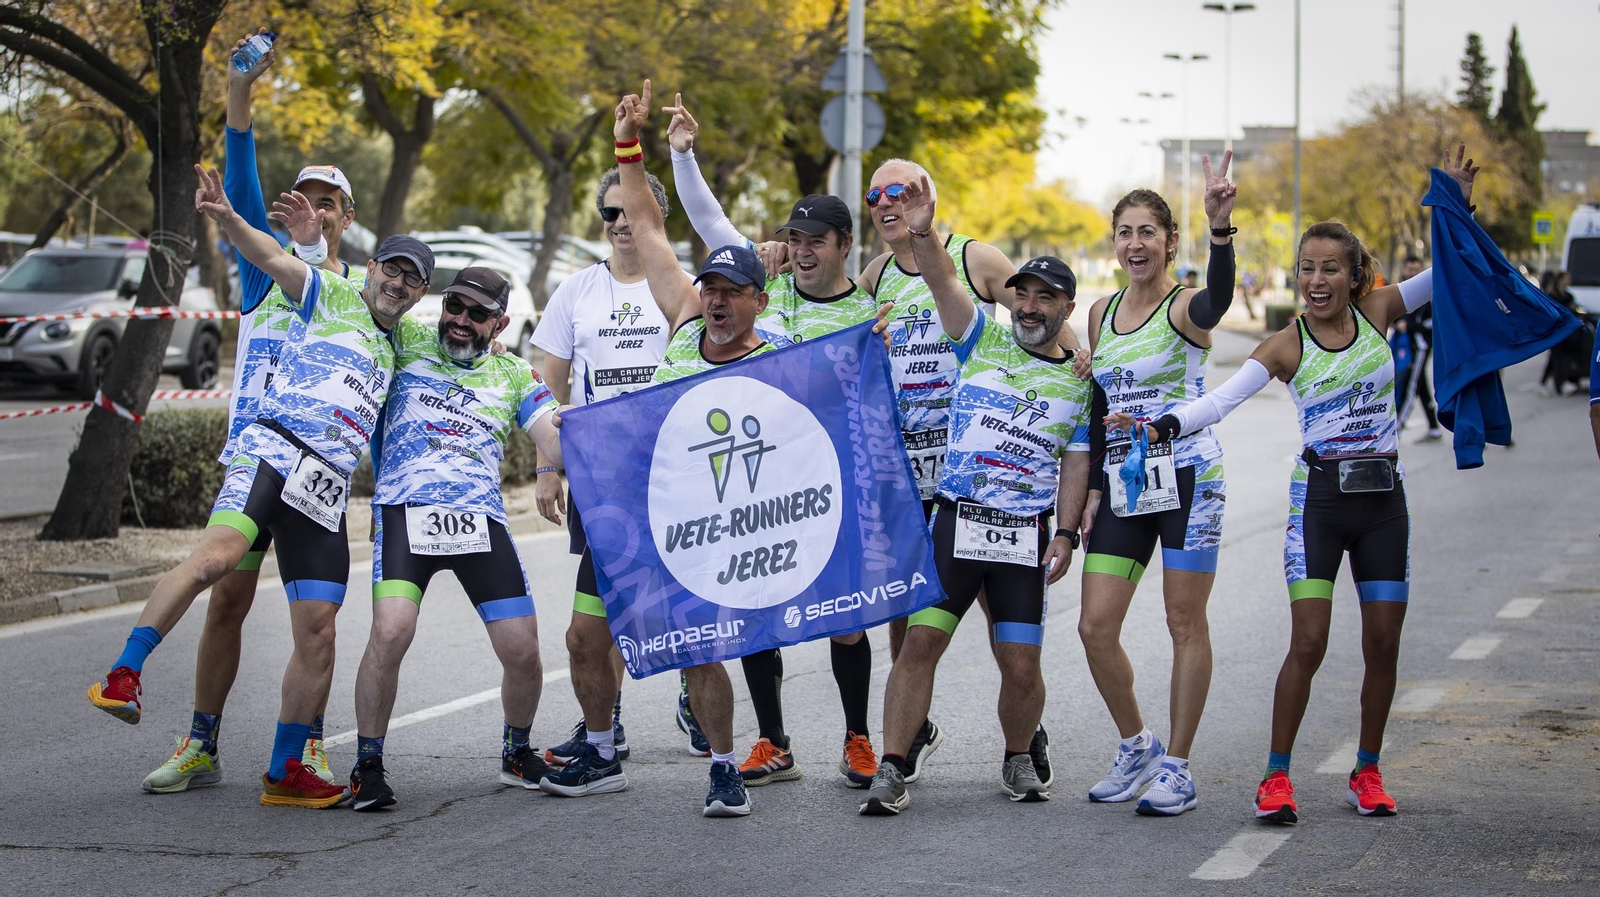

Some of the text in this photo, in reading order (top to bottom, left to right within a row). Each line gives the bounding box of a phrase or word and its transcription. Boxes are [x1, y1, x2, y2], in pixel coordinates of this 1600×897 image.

[711, 258, 735, 266] adidas
[598, 326, 661, 338] VETE-RUNNERS
[615, 339, 644, 349] JEREZ
[905, 360, 939, 375] JEREZ
[597, 376, 632, 385] POPULAR
[980, 414, 1056, 452] VETE-RUNNERS
[1341, 419, 1373, 433] JEREZ
[860, 403, 906, 490] JEREZ
[995, 440, 1035, 459] JEREZ
[824, 343, 898, 573] VETE-RUNNERS
[910, 454, 946, 480] 37
[305, 470, 343, 508] 323
[283, 491, 302, 506] enjoy!
[427, 512, 477, 537] 308
[665, 483, 833, 554] VETE-RUNNERS
[411, 543, 430, 553] enjoy!
[956, 549, 977, 558] enjoy!
[716, 538, 799, 586] JEREZ
[805, 571, 928, 622] SECOVISA
[727, 637, 747, 645] INOX
